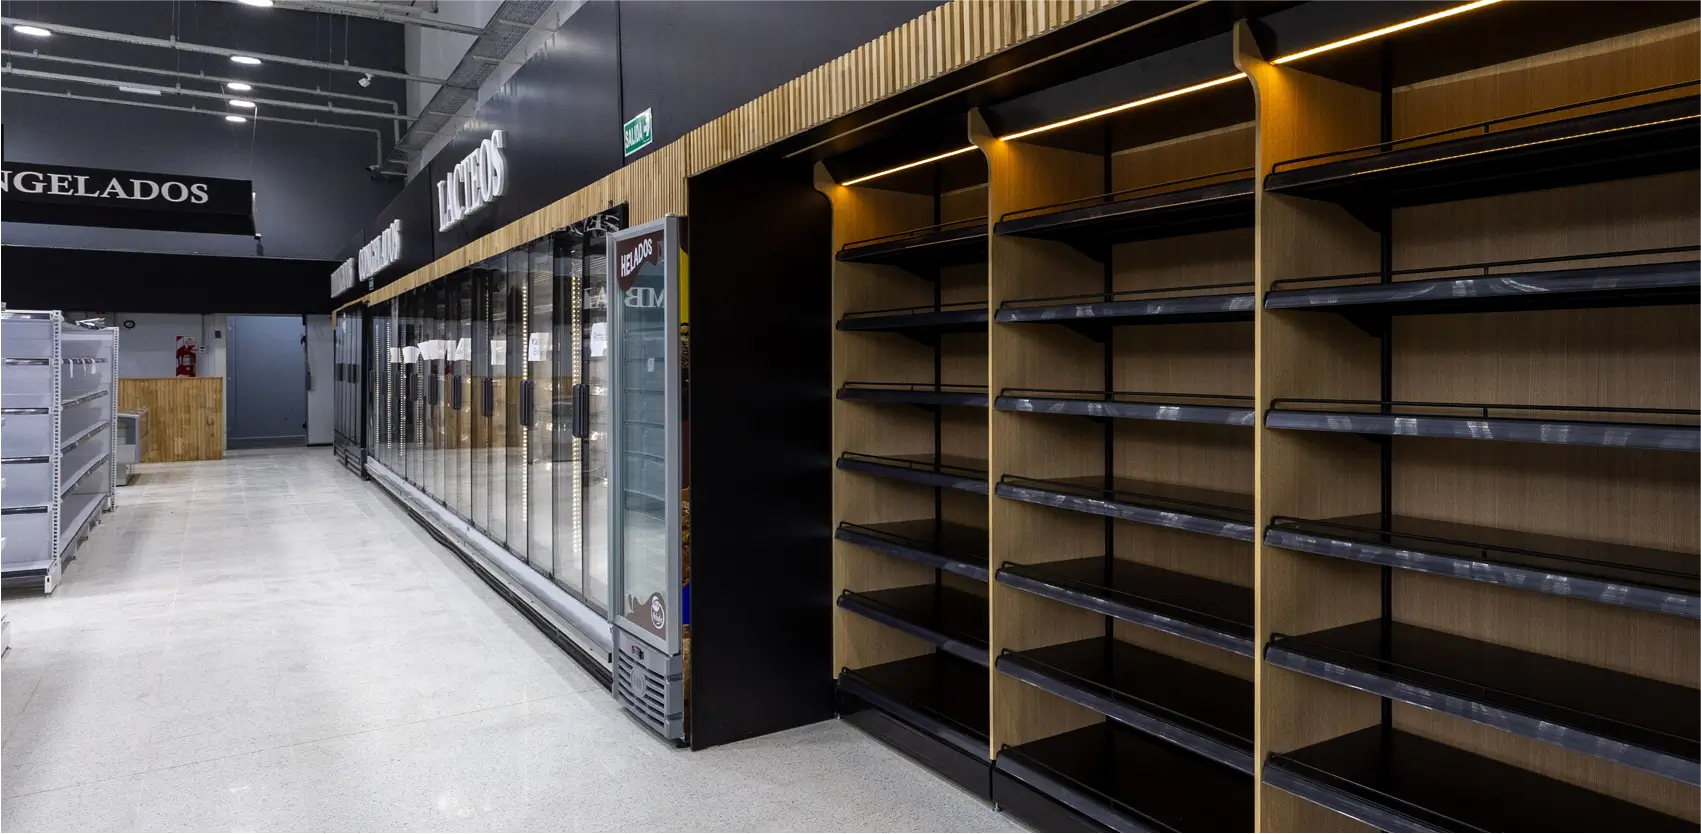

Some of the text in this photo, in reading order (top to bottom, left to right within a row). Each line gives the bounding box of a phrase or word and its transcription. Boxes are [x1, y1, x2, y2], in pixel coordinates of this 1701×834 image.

[625, 121, 643, 149] SALIDA
[437, 130, 504, 232] LACTEOS
[621, 238, 653, 277] HELADOS
